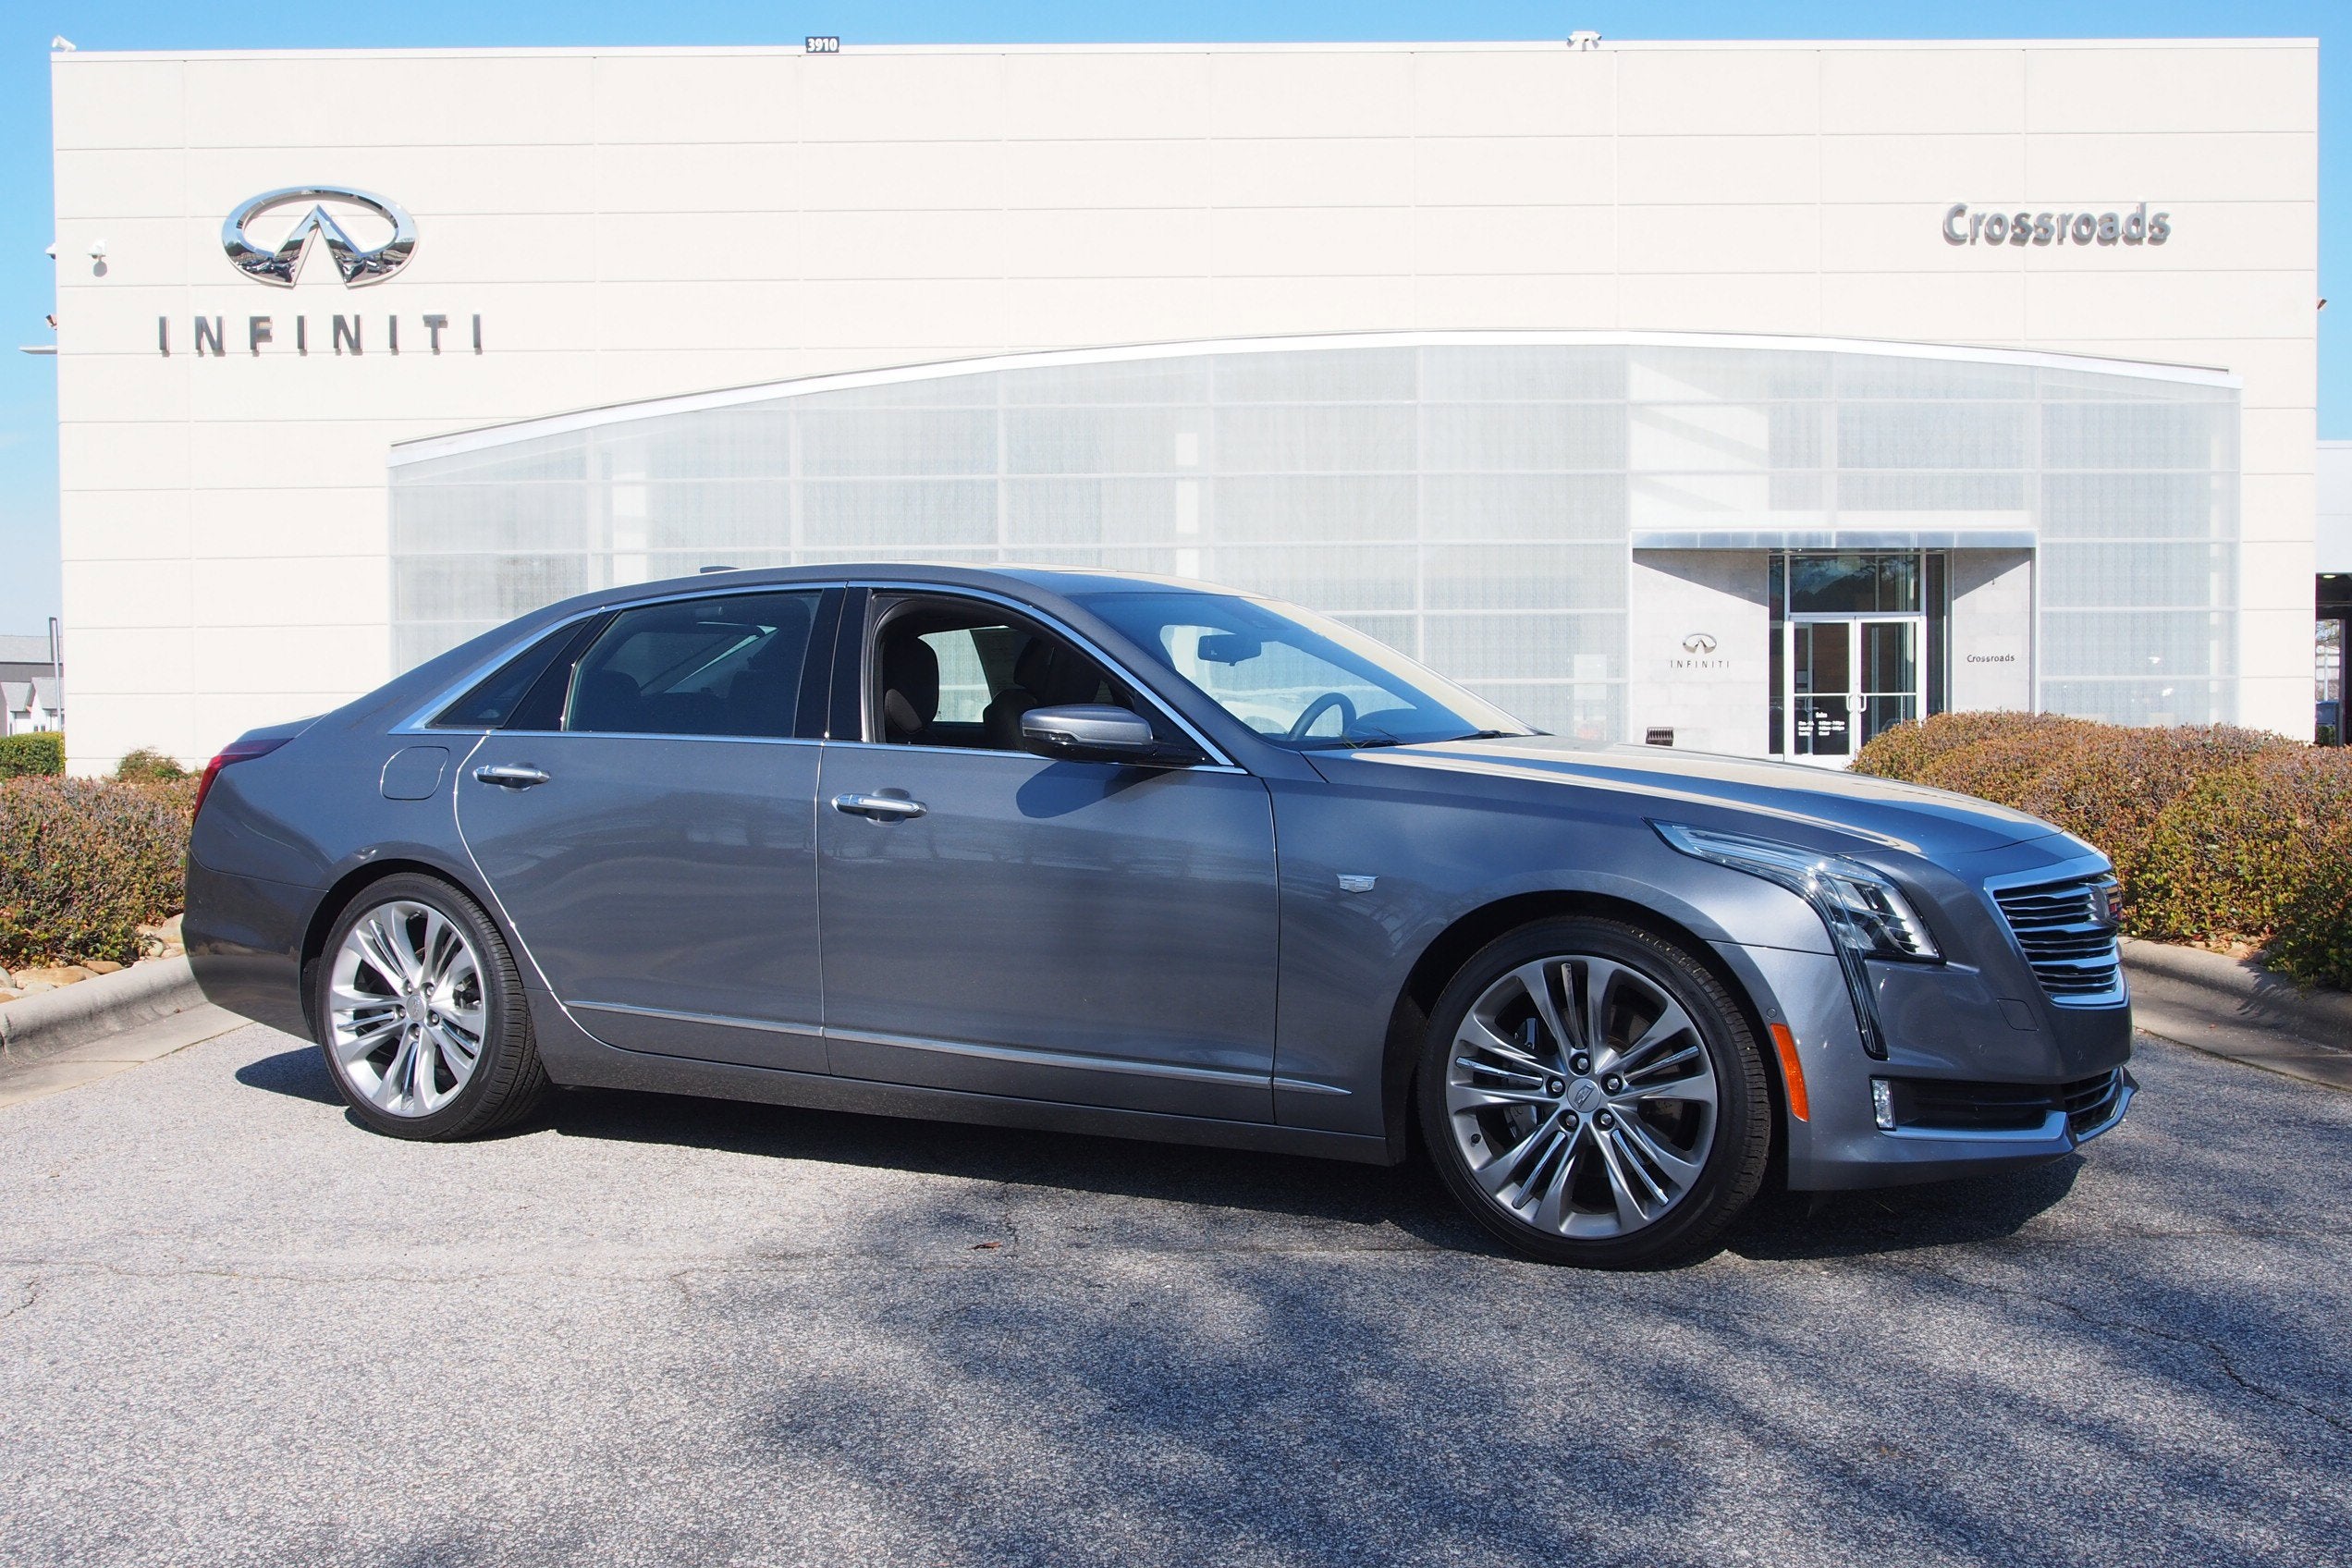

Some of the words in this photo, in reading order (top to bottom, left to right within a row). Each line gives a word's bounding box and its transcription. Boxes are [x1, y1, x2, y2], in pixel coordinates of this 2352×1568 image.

[807, 38, 838, 52] 3910
[1942, 202, 2172, 245] Crossroads
[158, 313, 482, 355] INFINITI
[1670, 659, 1730, 668] INFINITI
[1966, 653, 2015, 663] Crossroads
